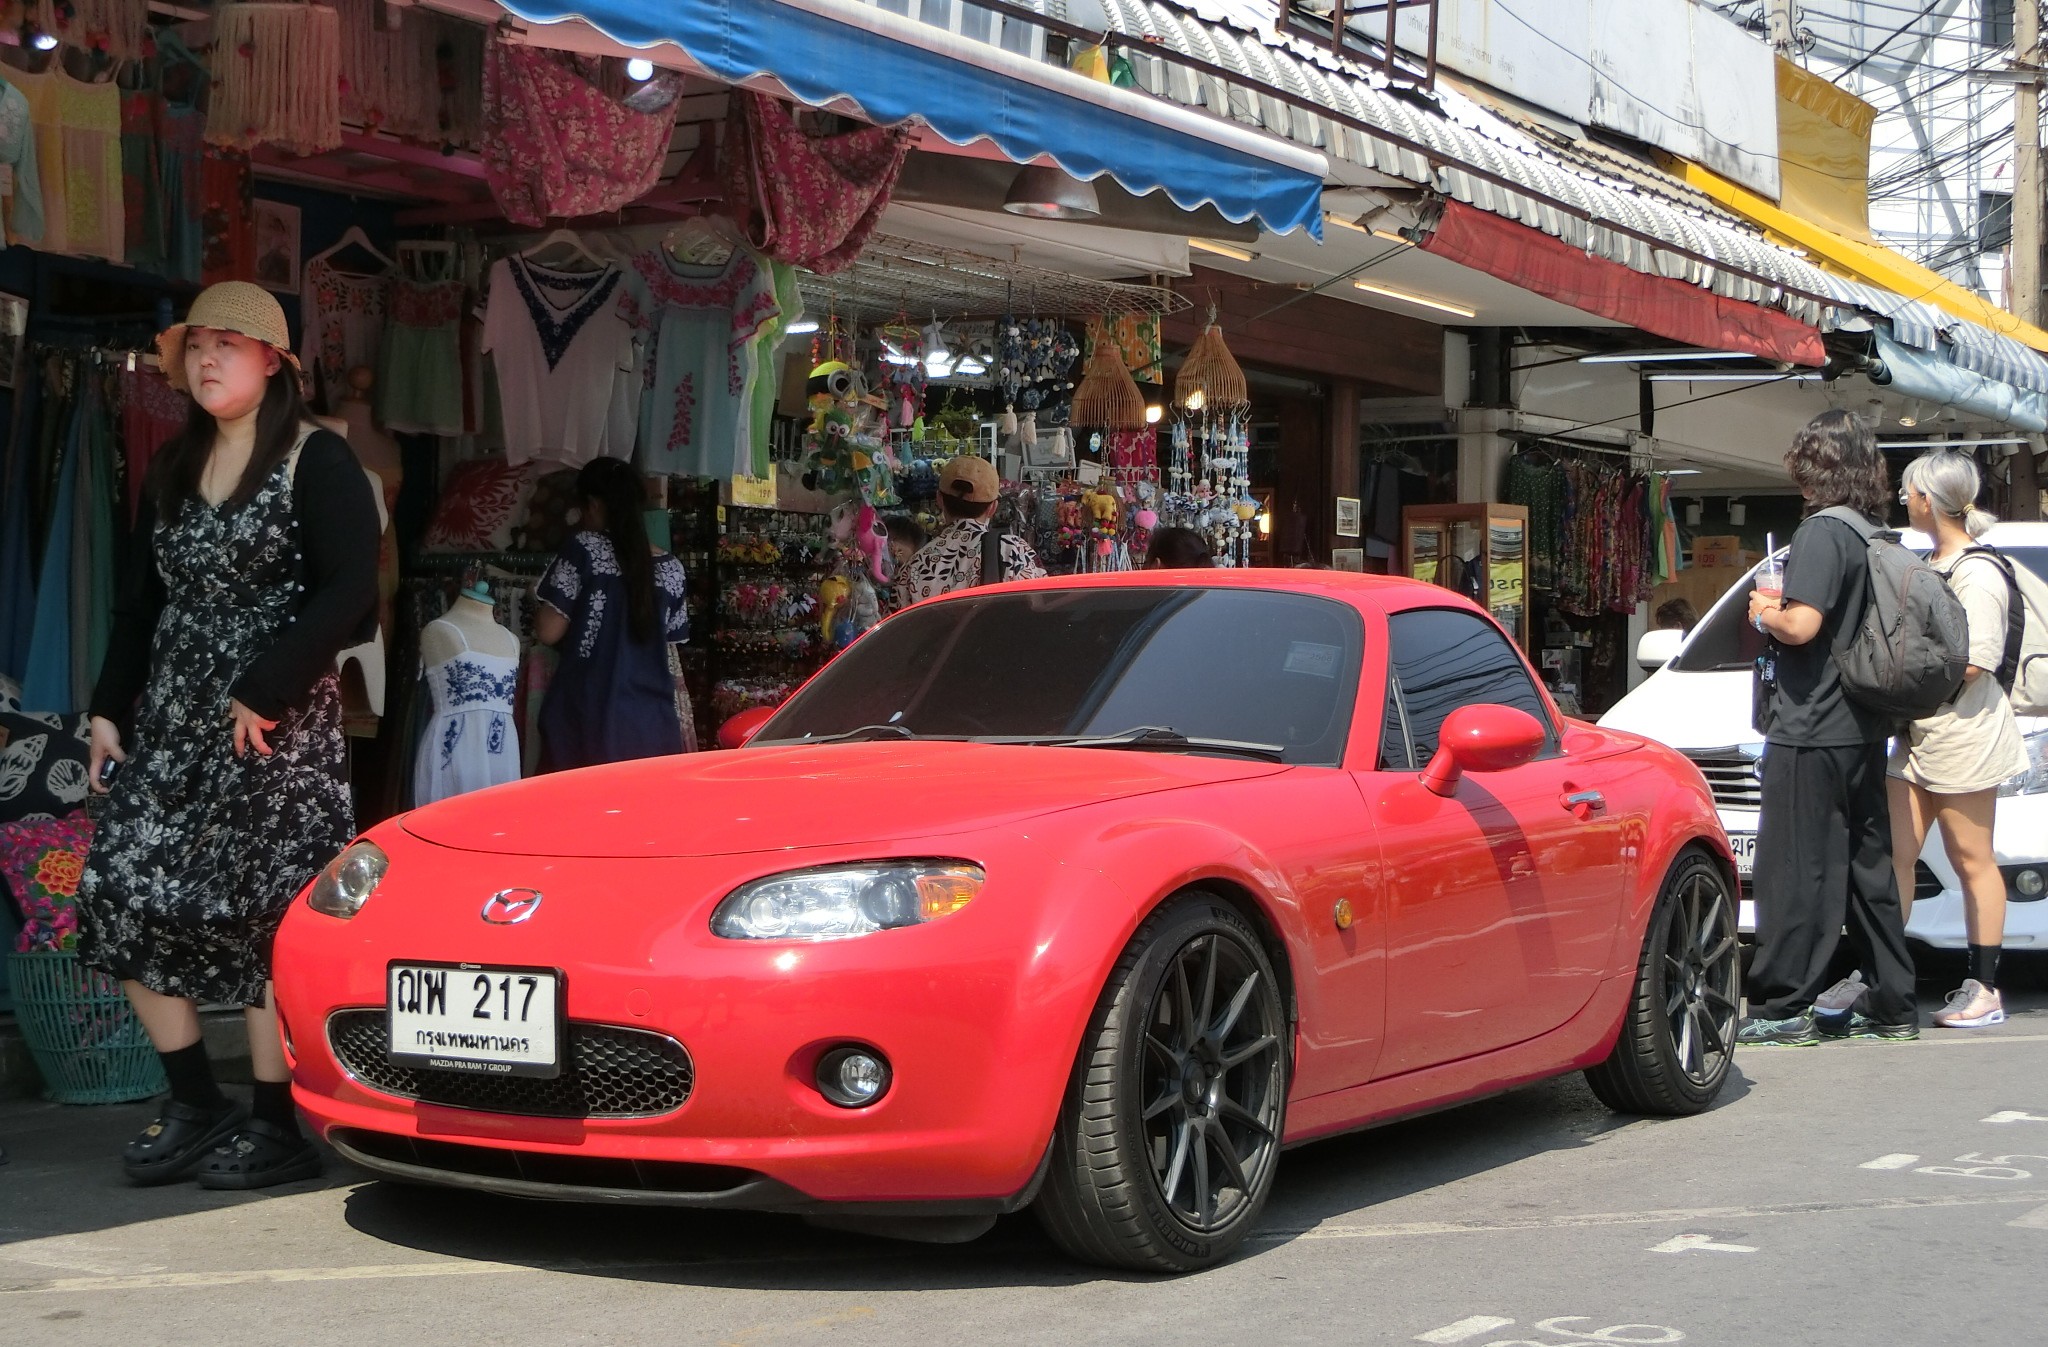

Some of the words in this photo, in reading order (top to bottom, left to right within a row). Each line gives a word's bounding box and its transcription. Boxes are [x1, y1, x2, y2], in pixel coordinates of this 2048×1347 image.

[472, 973, 539, 1022] 217
[416, 1029, 530, 1053] กรุงเทพมหานคร
[429, 1058, 454, 1068] MAZDA
[454, 1060, 467, 1069] PRA
[467, 1062, 483, 1070] RAM
[483, 1063, 488, 1071] 7
[488, 1063, 512, 1073] GROUP
